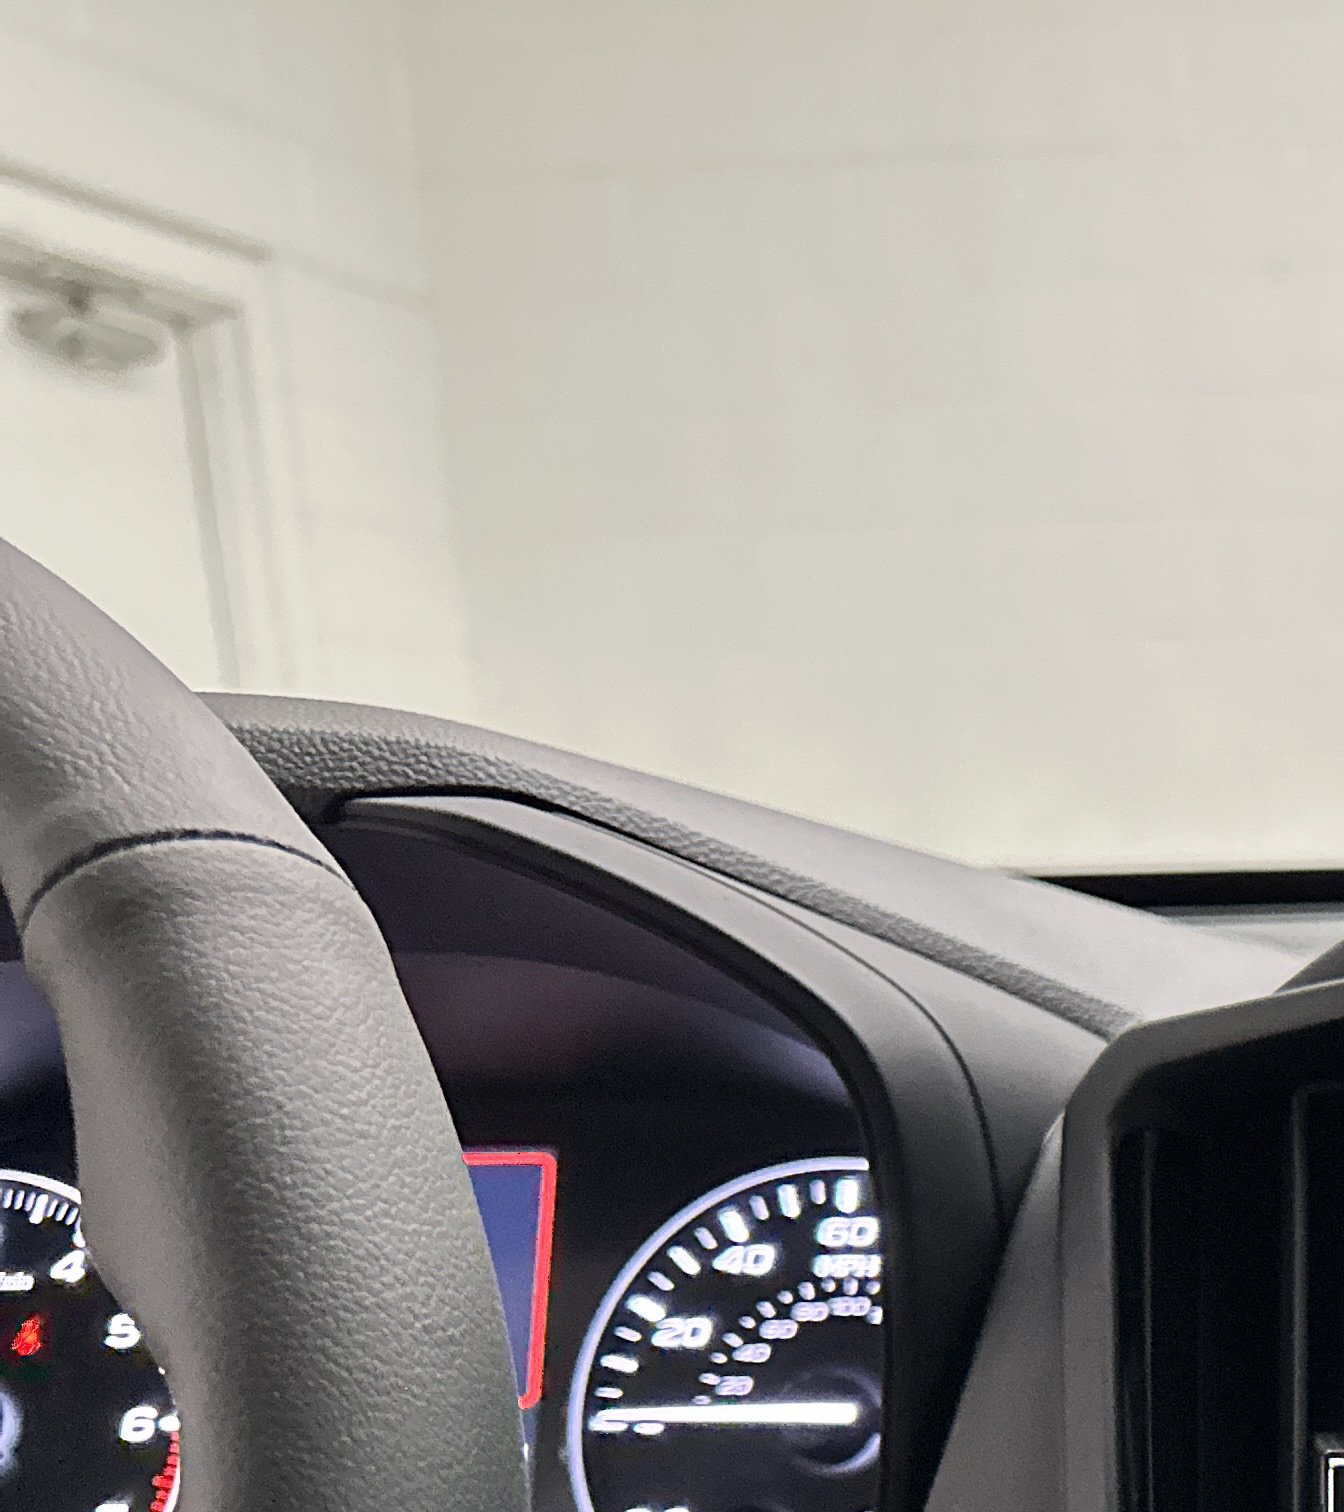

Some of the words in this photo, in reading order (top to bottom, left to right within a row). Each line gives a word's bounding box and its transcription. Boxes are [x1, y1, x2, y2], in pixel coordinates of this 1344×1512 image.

[816, 1216, 880, 1248] 60
[712, 1244, 776, 1277] 40
[104, 1313, 142, 1350] 5
[651, 1316, 713, 1349] 20
[119, 1405, 159, 1443] 6
